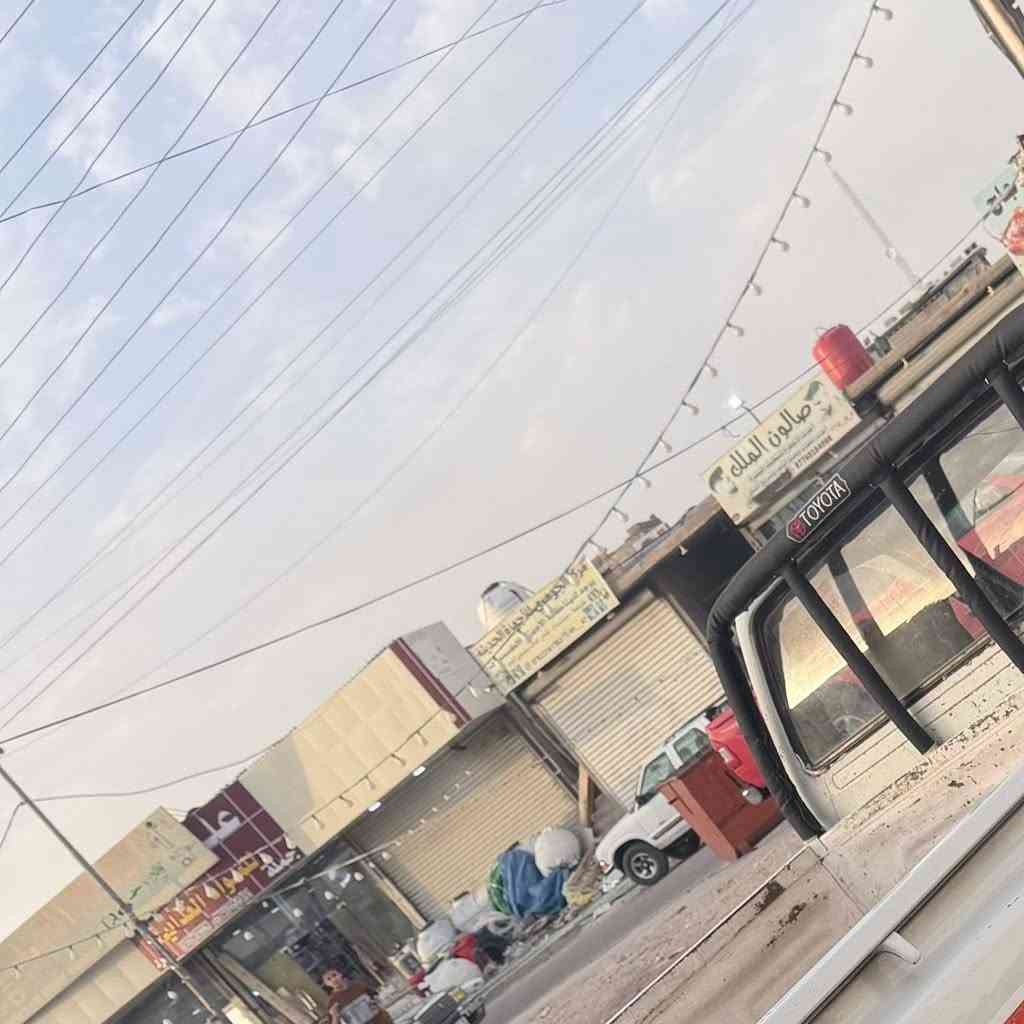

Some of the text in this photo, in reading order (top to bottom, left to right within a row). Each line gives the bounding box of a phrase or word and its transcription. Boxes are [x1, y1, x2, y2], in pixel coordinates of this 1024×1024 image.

[768, 404, 812, 447] صالون
[730, 435, 766, 477] الملك
[799, 478, 846, 527] TOYOTA
